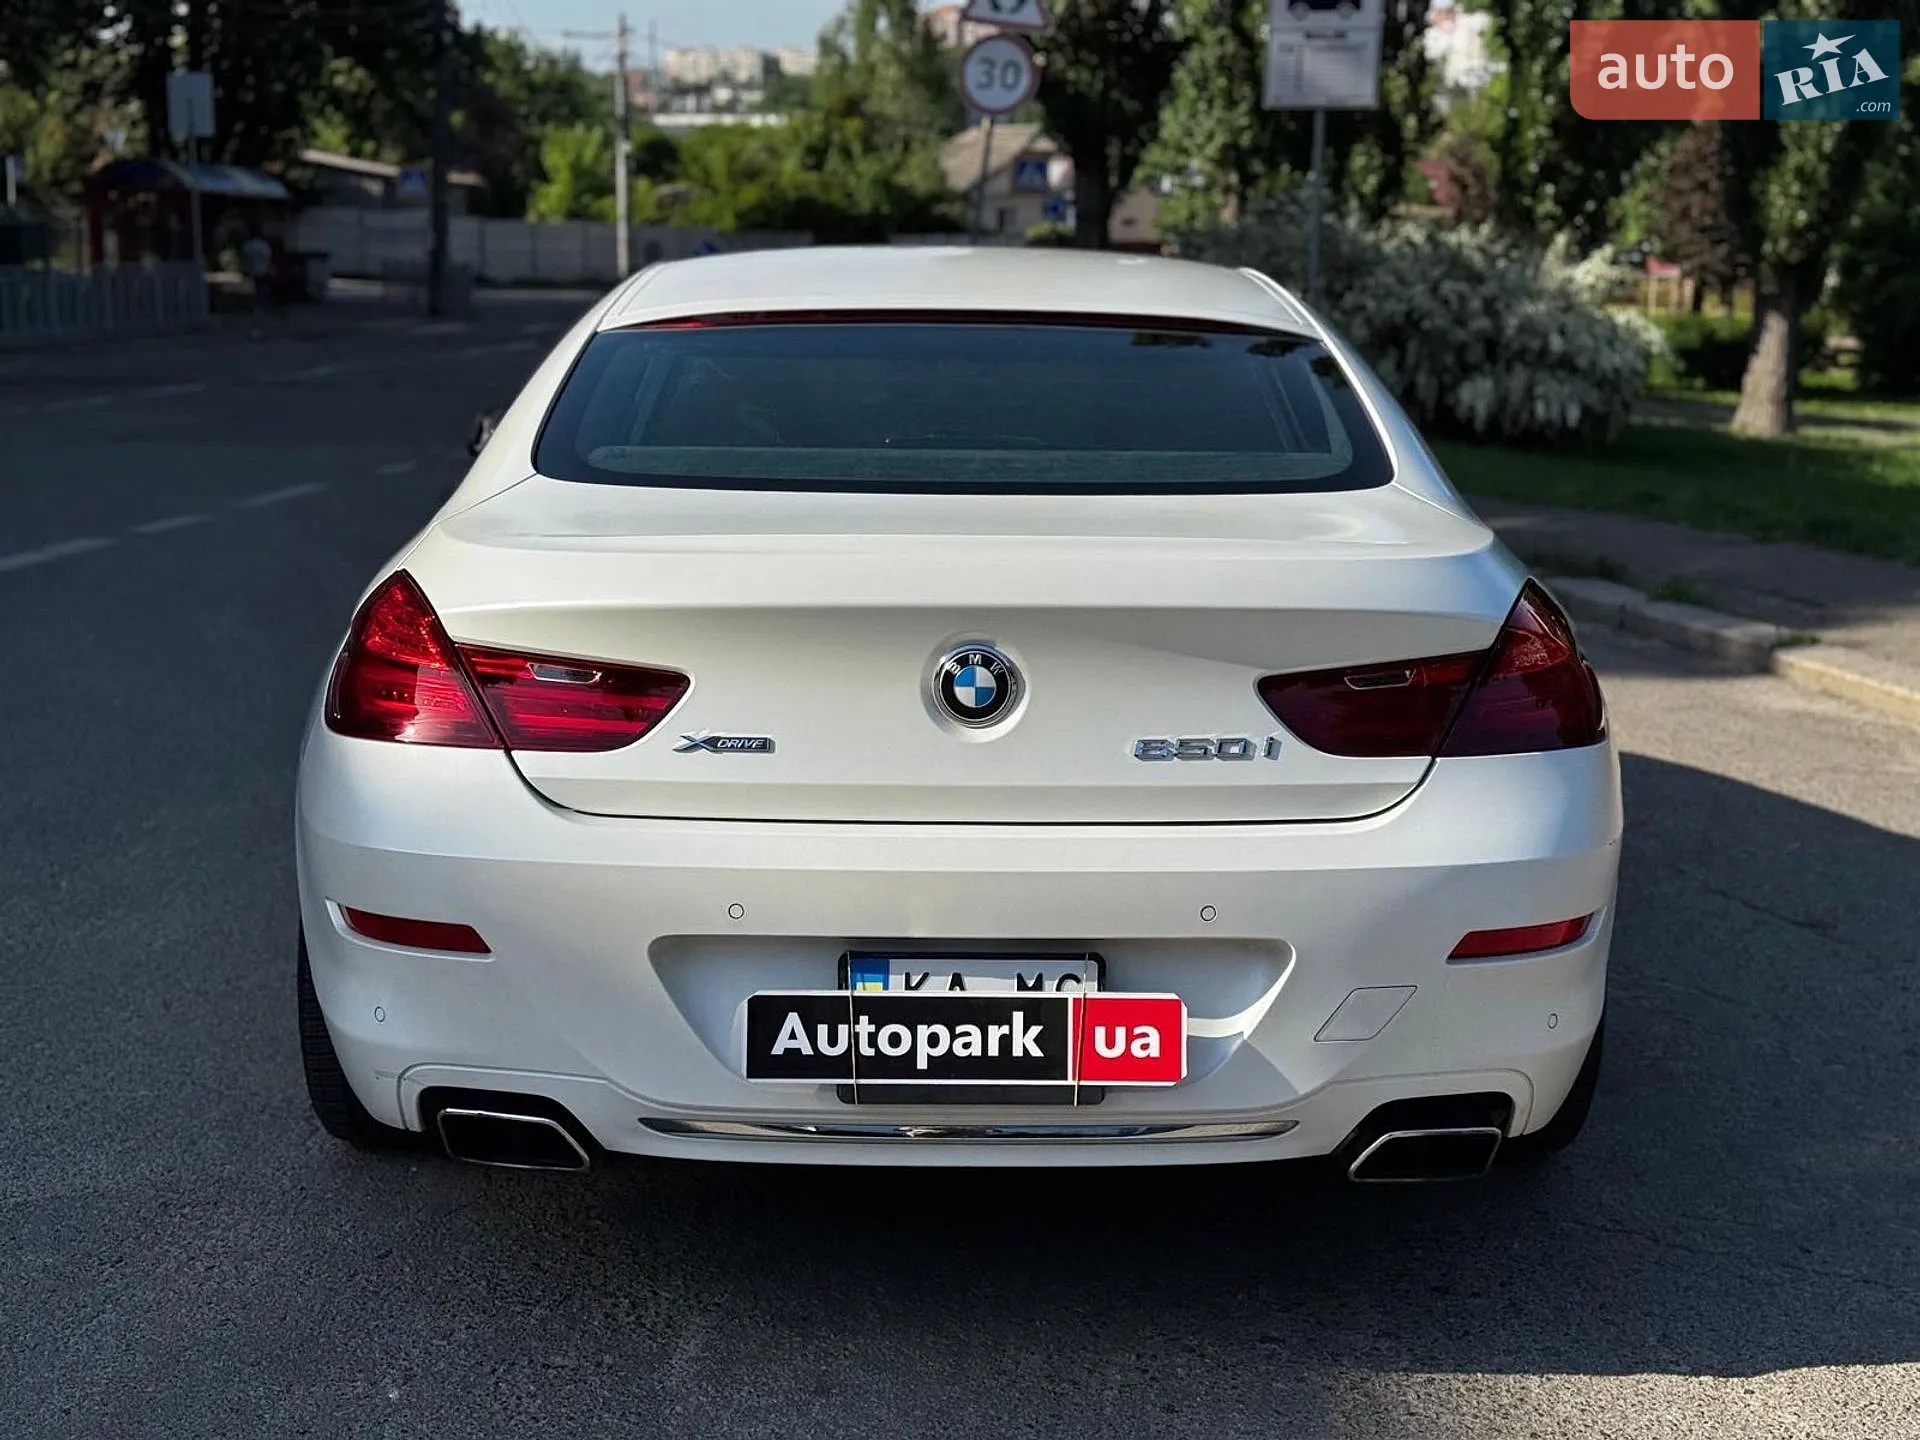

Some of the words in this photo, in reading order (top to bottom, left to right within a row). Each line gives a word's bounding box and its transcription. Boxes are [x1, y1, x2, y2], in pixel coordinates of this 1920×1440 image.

[975, 57, 1022, 92] 30
[945, 653, 1005, 676] BMW
[771, 1011, 1045, 1070] Autopark
[1094, 1024, 1161, 1059] ua
